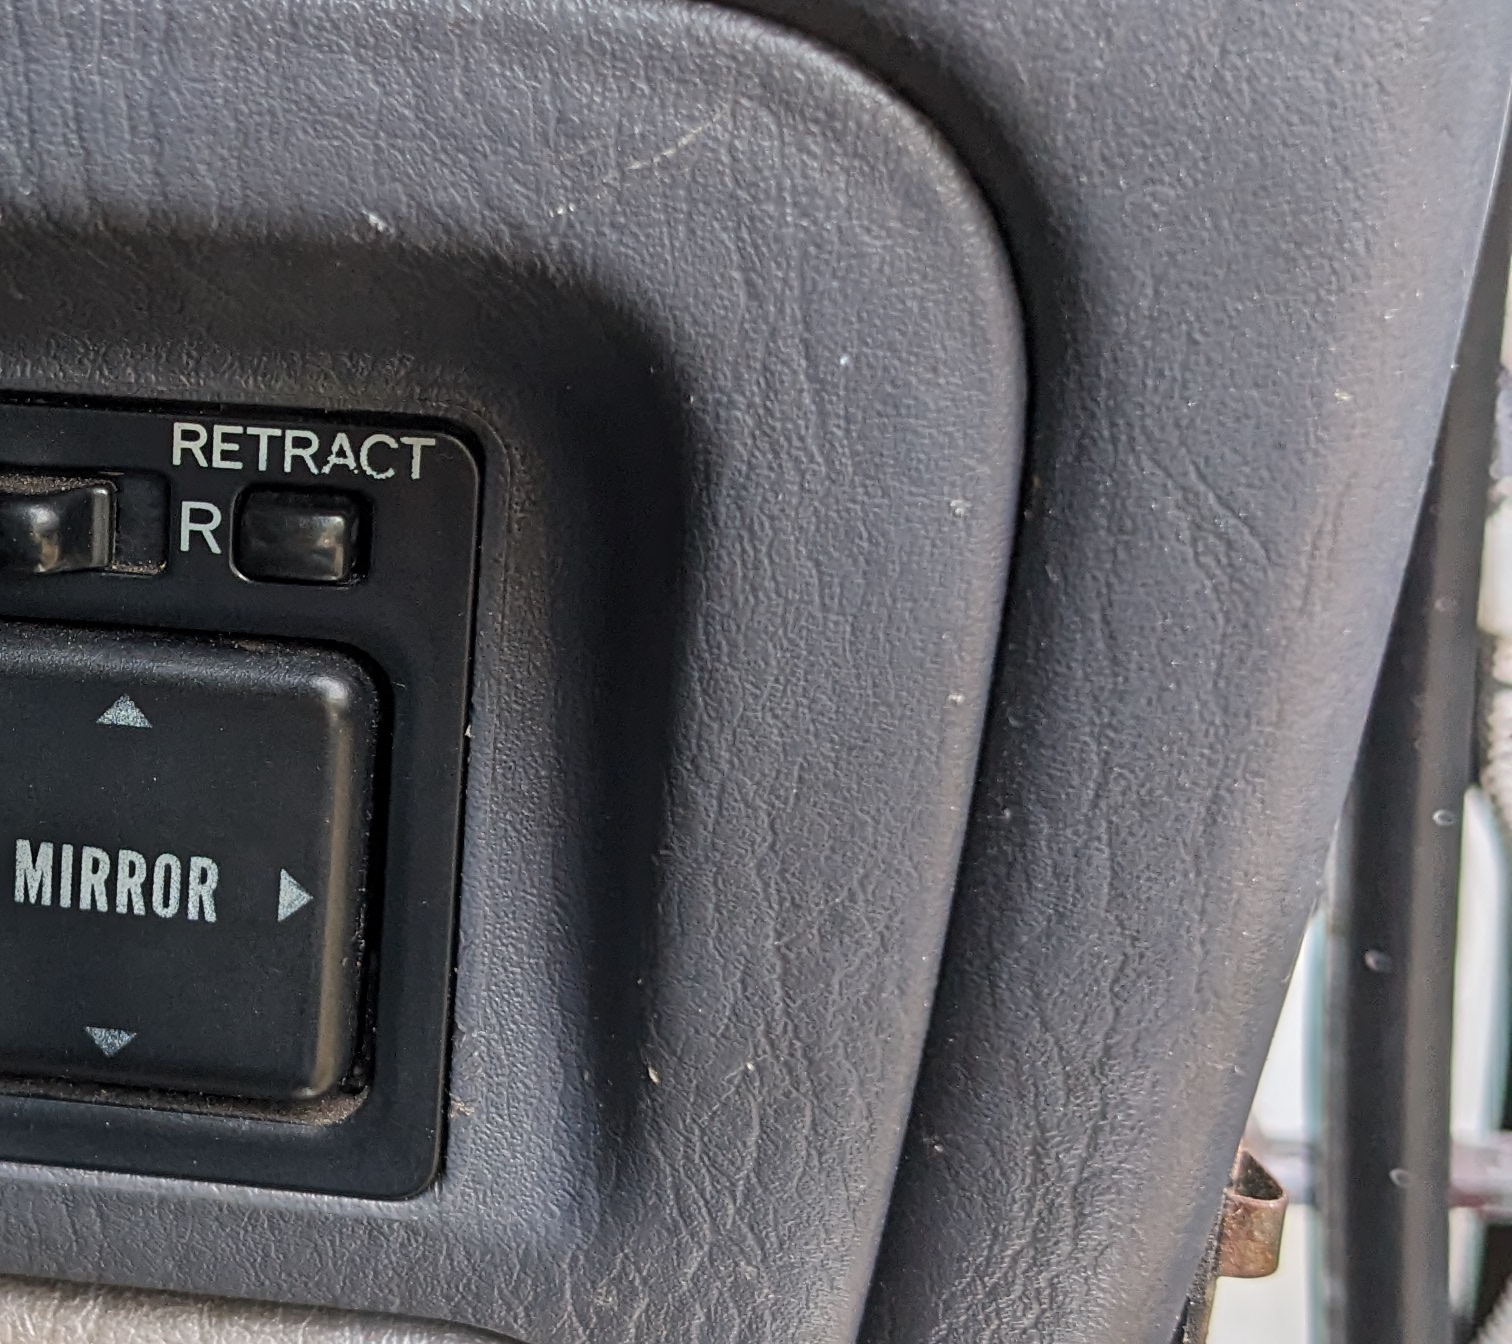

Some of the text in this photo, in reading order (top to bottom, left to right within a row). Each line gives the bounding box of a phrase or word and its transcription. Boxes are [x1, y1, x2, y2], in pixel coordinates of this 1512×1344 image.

[171, 421, 437, 480] RETRACT
[179, 500, 223, 554] R
[13, 838, 220, 923] MIRROR
